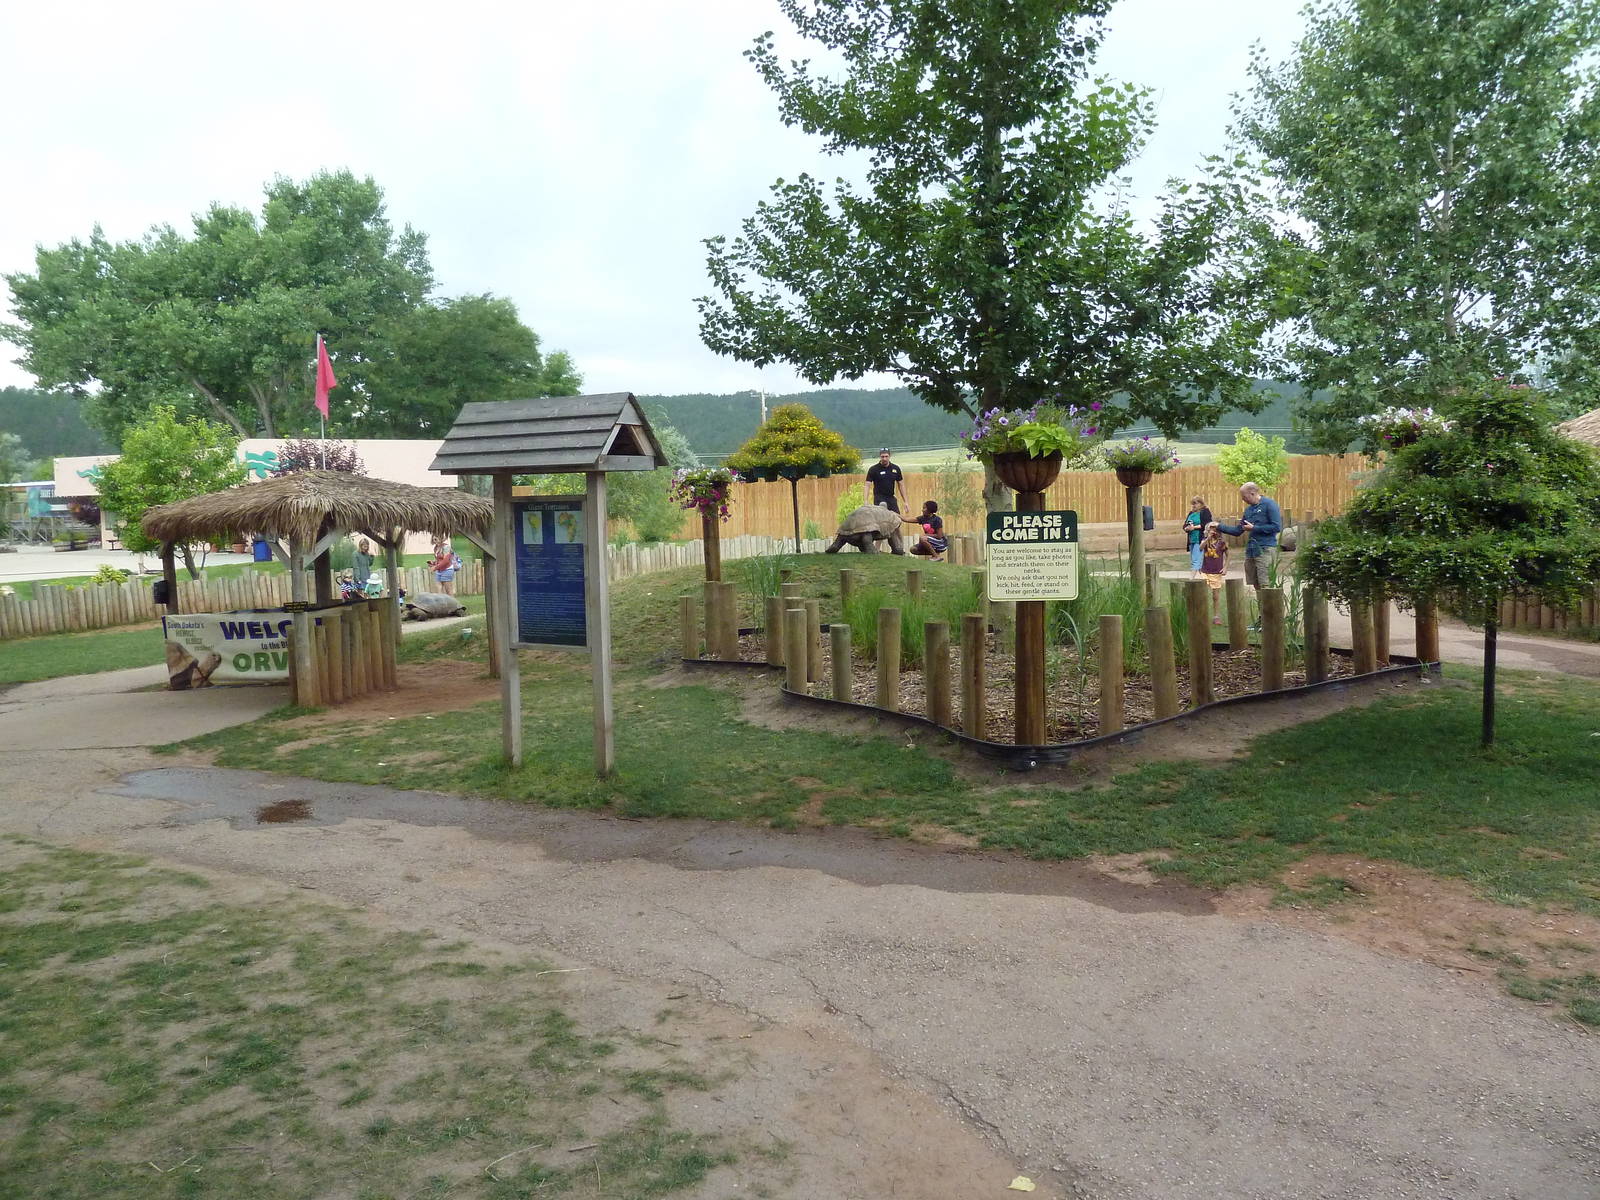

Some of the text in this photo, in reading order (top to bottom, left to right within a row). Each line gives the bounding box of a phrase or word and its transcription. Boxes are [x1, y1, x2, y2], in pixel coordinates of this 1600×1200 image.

[1004, 515, 1062, 528] PLEASE
[992, 526, 1070, 541] COME IN !
[269, 641, 280, 649] the
